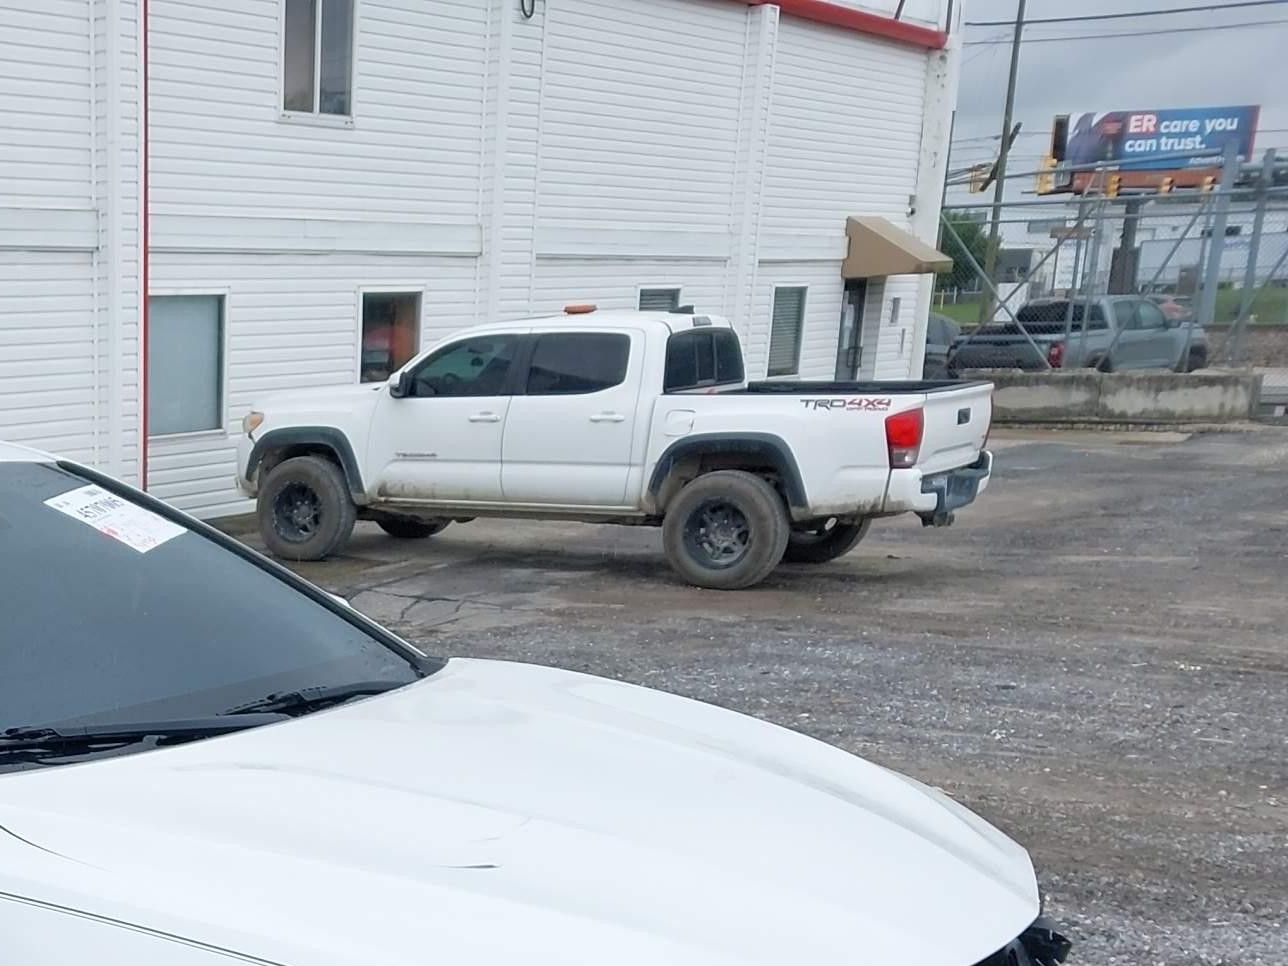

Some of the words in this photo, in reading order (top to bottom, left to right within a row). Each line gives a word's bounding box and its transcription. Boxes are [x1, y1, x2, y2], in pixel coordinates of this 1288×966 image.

[1128, 114, 1157, 133] ER
[1159, 119, 1200, 133] care
[1204, 117, 1239, 136] you
[1124, 139, 1157, 152] can
[1159, 134, 1207, 151] trust.
